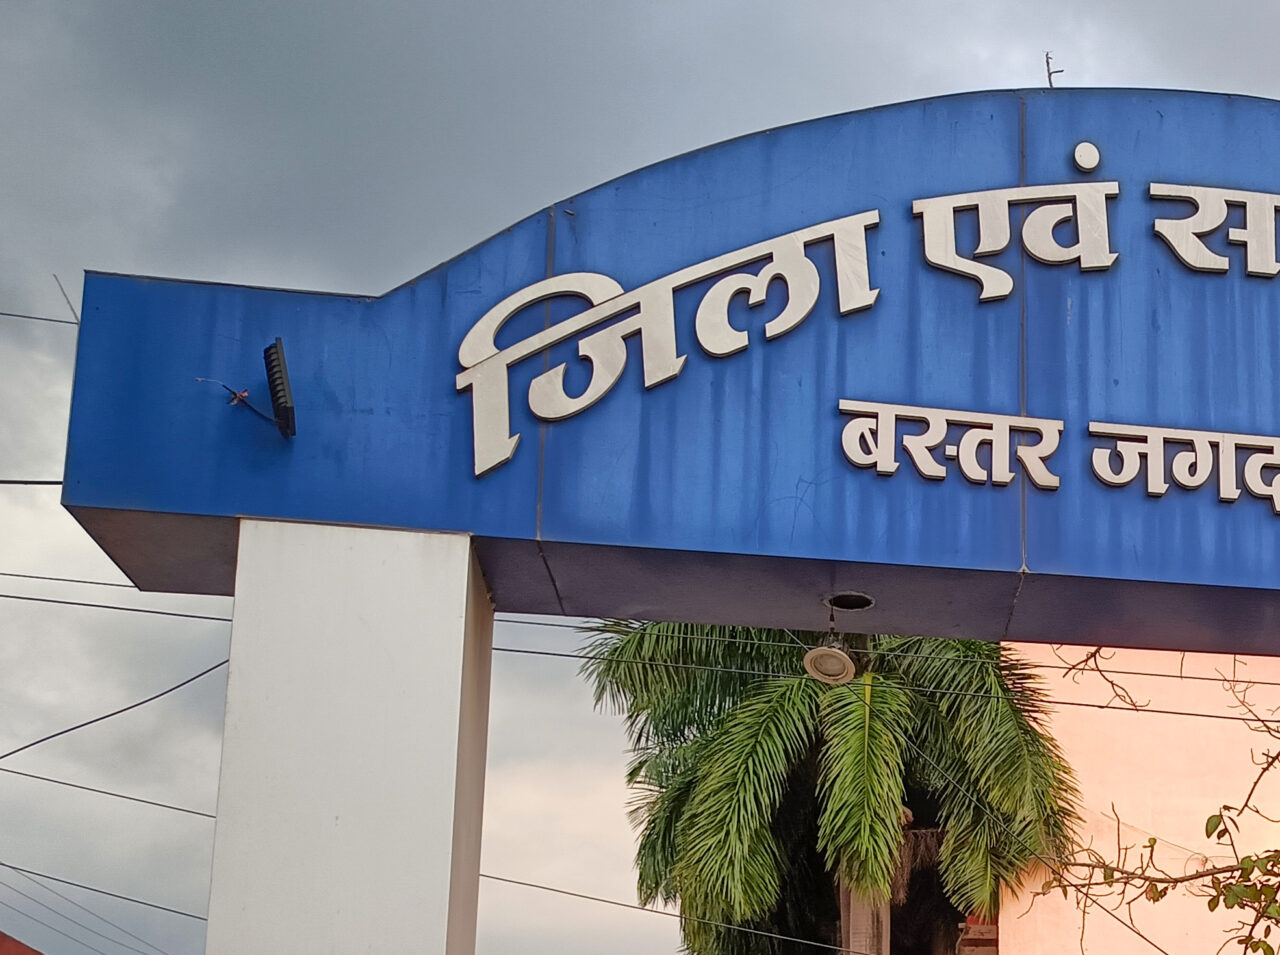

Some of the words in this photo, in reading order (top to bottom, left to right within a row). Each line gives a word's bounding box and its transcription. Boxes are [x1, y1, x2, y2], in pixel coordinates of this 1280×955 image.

[455, 209, 881, 477] जिला
[912, 141, 1120, 302] एवं
[838, 399, 1064, 491] बस्तर
